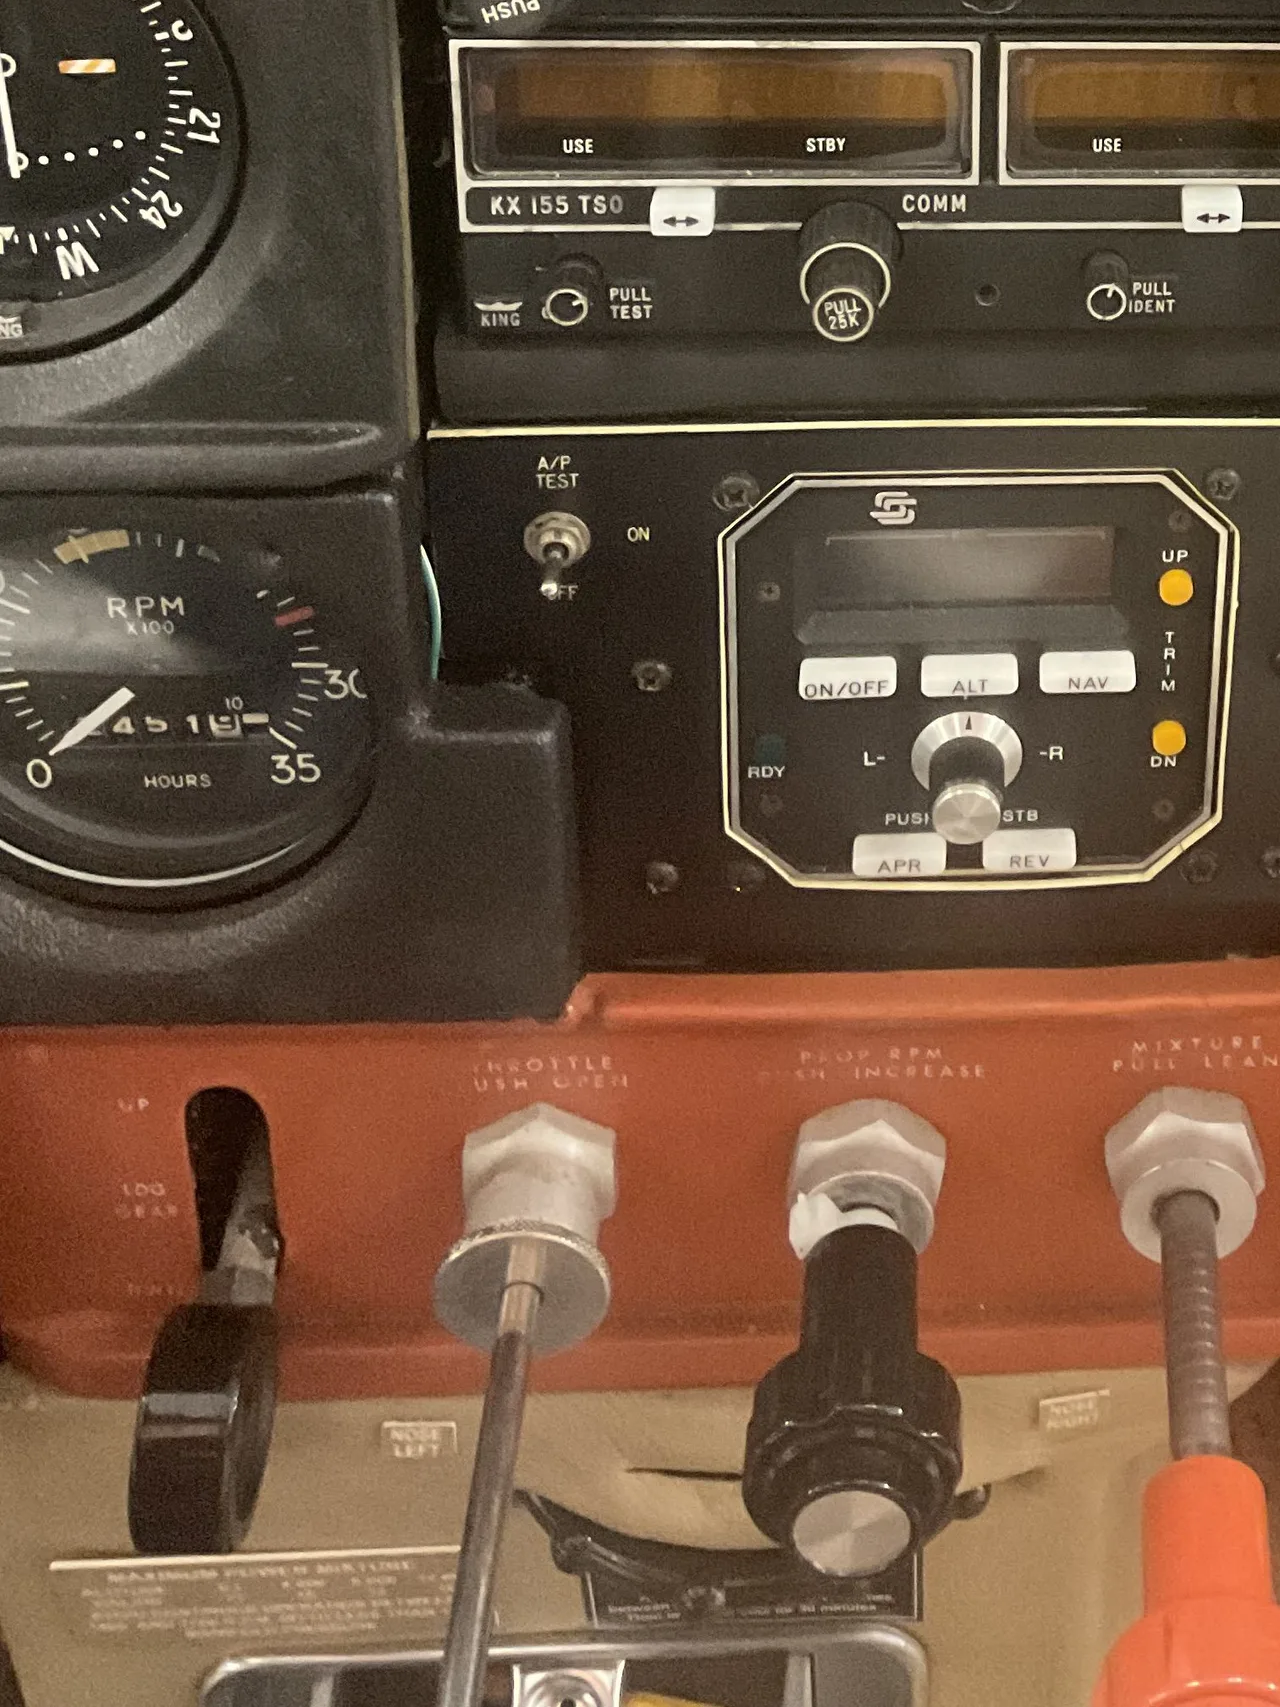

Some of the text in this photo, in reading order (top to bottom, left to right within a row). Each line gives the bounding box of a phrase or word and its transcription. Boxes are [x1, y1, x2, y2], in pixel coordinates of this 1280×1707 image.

[562, 138, 594, 154] USE
[806, 137, 846, 152] STBY
[1093, 138, 1122, 153] USE
[139, 190, 183, 229] 24
[490, 195, 623, 215] KX 155 TSO
[902, 194, 967, 212] COMM
[56, 242, 100, 280] W
[609, 287, 651, 302] PULL
[1133, 281, 1172, 297] PULL
[611, 304, 653, 319] TEST
[823, 298, 862, 316] PULL
[1129, 299, 1176, 314] IDENT
[480, 313, 521, 327] KING
[828, 313, 860, 329] 25K
[537, 455, 571, 471] A/P
[536, 473, 580, 489] TEST
[627, 526, 651, 542] ON
[1162, 549, 1189, 563] UP
[107, 597, 186, 618] RPM
[1161, 630, 1176, 693] TRIM
[804, 679, 889, 699] ON/OFF
[952, 678, 989, 694] ALT
[1068, 676, 1109, 691] NAV
[225, 696, 243, 710] 10
[271, 754, 321, 784] 35
[1150, 755, 1177, 768] DN
[26, 758, 53, 789] 0
[748, 765, 785, 779] RDY
[144, 774, 212, 788] HOURS
[878, 858, 922, 874] APR
[1009, 854, 1050, 869] REV
[1131, 1035, 1263, 1054] MIXTURE
